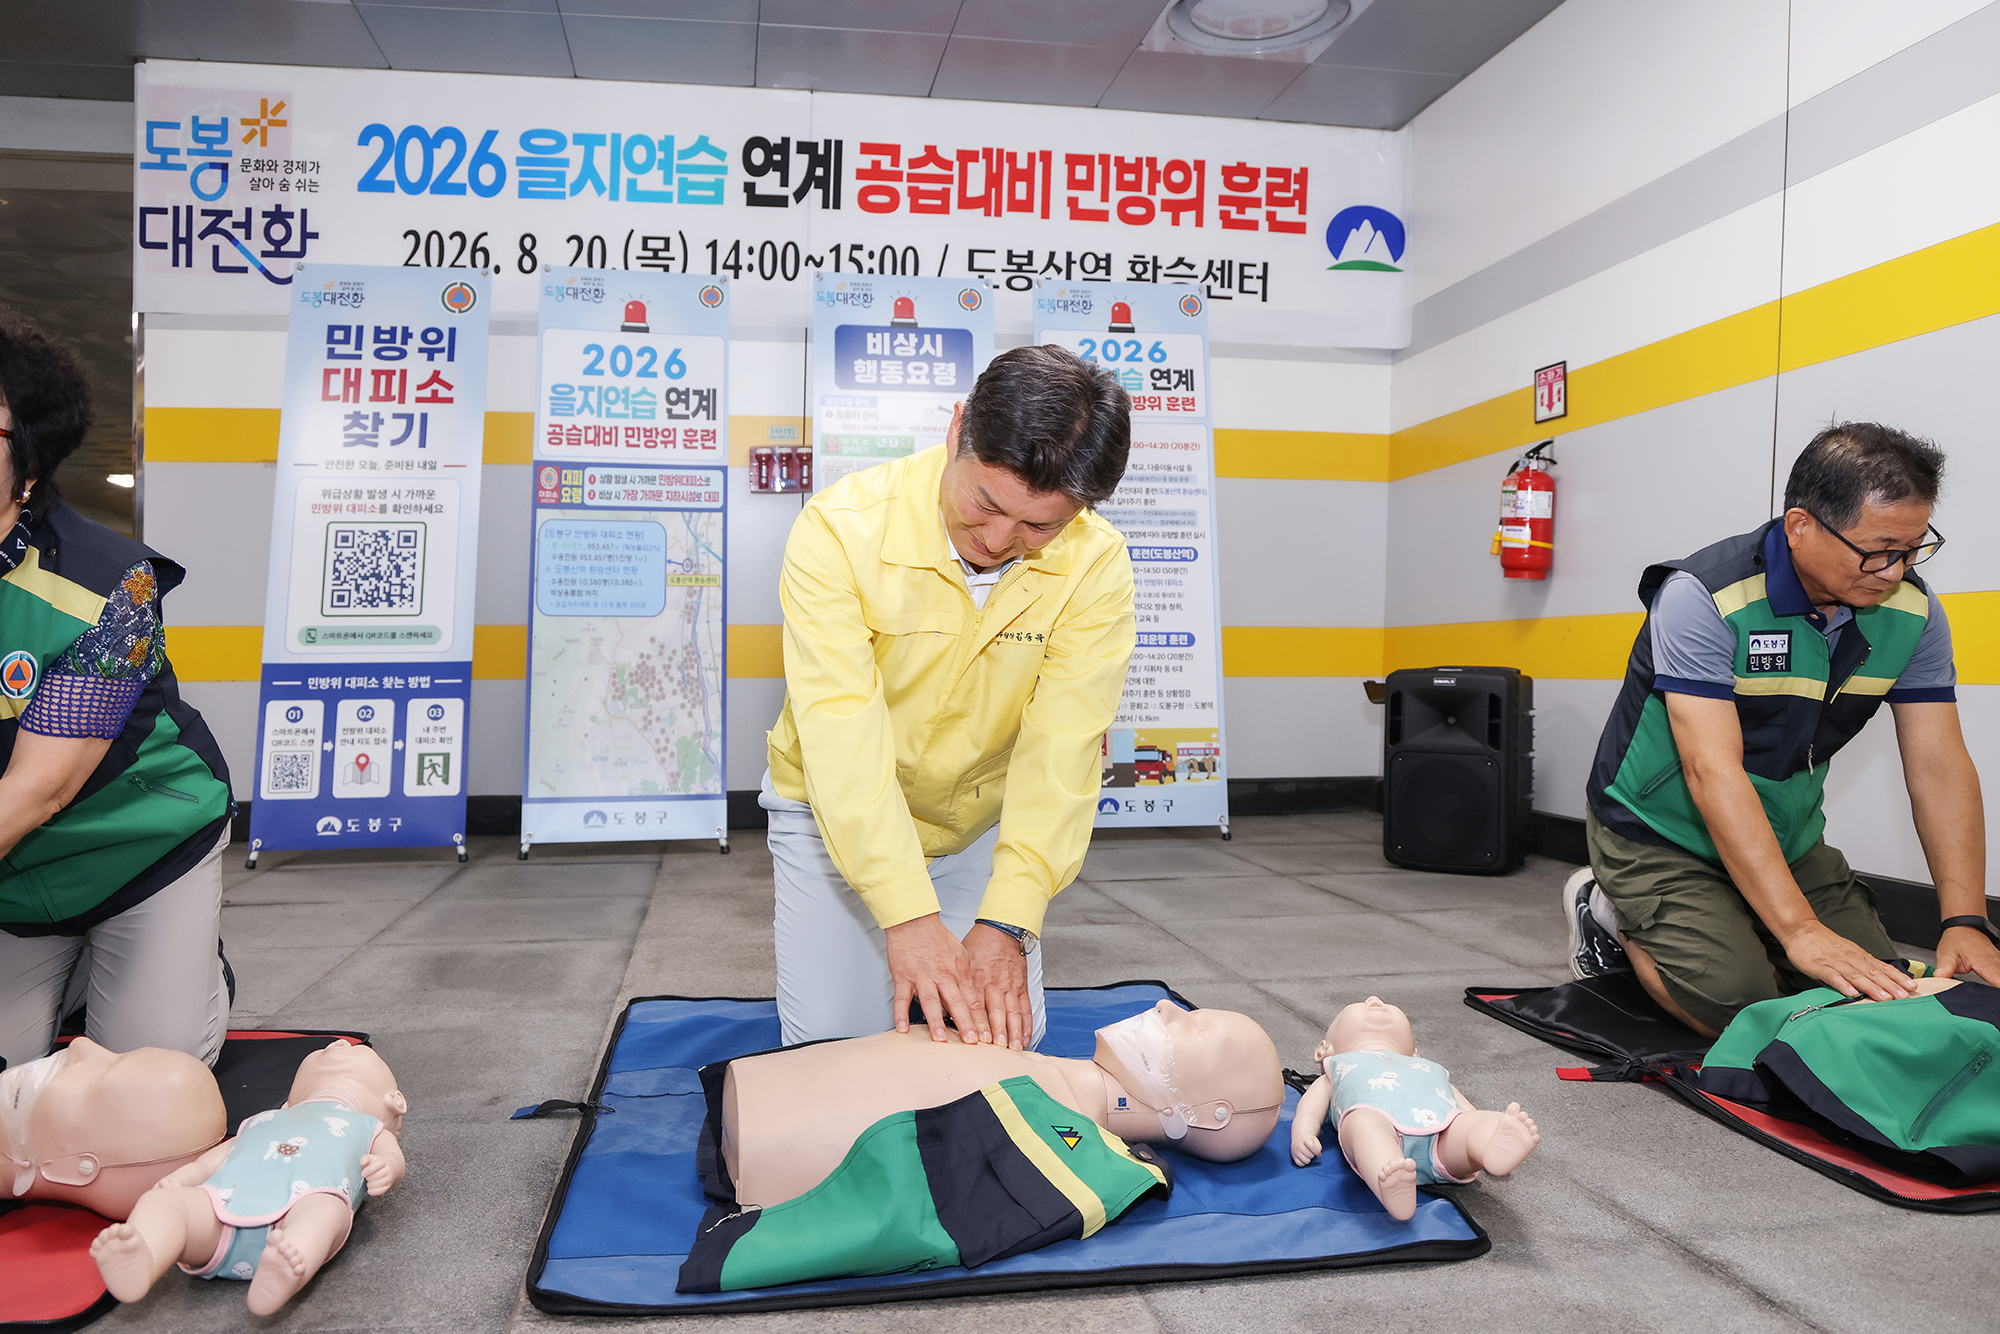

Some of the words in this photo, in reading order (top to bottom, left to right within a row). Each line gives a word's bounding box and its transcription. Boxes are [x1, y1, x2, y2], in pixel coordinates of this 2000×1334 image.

[140, 116, 232, 201] 도봉
[240, 158, 278, 173] 문화와
[282, 160, 320, 174] 경제가
[249, 177, 274, 191] 살아
[279, 178, 290, 192] 숨
[295, 178, 320, 193] 쉬는
[357, 124, 506, 197] 2026
[516, 128, 728, 205] 을지연습
[742, 135, 842, 210] 연계
[855, 141, 1052, 219] 공습대비
[1064, 153, 1205, 227] 민방위
[1217, 161, 1309, 235] 훈련
[139, 204, 319, 285] 대전환
[402, 229, 500, 275] 2026.
[705, 239, 920, 282] 14:00~15:00
[937, 243, 949, 278] /
[326, 324, 457, 362] 민방위
[866, 332, 943, 358] 비상시
[1078, 338, 1167, 363] 2026
[582, 343, 687, 380] 2026
[854, 359, 957, 386] 행동요령
[321, 367, 454, 404] 대피소
[1101, 367, 1144, 391] 습
[1150, 368, 1195, 392] 연계
[549, 383, 658, 420] 을지연습
[665, 387, 717, 421] 연계
[1166, 396, 1196, 412] 훈련
[343, 410, 428, 448] 찾기
[547, 423, 619, 447] 공습대비
[624, 426, 677, 450] 민방위
[682, 428, 717, 451] 훈련
[1171, 442, 1200, 451] (20분간)
[324, 459, 354, 470] 안전한
[358, 460, 380, 471] 오늘,
[384, 460, 414, 471] 준비된
[417, 460, 437, 471] 내일
[1132, 464, 1146, 472] 학교,
[1147, 464, 1185, 472] 다중이용시설
[561, 469, 583, 486] 대피
[599, 474, 613, 485] 상황
[614, 475, 628, 485] 발생
[629, 475, 636, 486] 시
[637, 475, 657, 486] 가까운
[658, 475, 711, 487] 민방위대피소로
[321, 488, 363, 500] 위급상황
[366, 489, 388, 500] 발생
[391, 489, 401, 500] 시
[404, 489, 436, 500] 가까운
[561, 487, 582, 503] 요령
[598, 490, 612, 500] 비상
[613, 490, 621, 500] 시
[622, 490, 638, 501] 가장
[640, 490, 663, 501] 가까운
[665, 490, 702, 502] 지하시설로
[704, 491, 719, 503] 대피
[311, 503, 342, 514] 민방위
[346, 503, 388, 514] 대피소를
[392, 503, 444, 514] 확인하세요
[1143, 498, 1156, 506] 훈련
[1131, 548, 1194, 559] 훈련(도봉산역)
[1162, 567, 1188, 575] (50분간)
[1169, 634, 1188, 645] 훈련
[1763, 640, 1786, 648] 도봉구
[1167, 653, 1193, 661] (20분간)
[1750, 655, 1786, 670] 민방위
[1143, 665, 1162, 673] 지휘차
[1164, 665, 1170, 673] 등
[1172, 665, 1183, 673] 6대
[307, 677, 342, 690] 민방위
[344, 677, 379, 690] 대피소
[382, 676, 405, 690] 찾는
[407, 676, 431, 689] 방법
[1142, 677, 1155, 685] 대한
[1143, 690, 1156, 698] 훈련
[1157, 690, 1164, 698] 등
[1166, 690, 1191, 698] 상황점검
[1130, 702, 1149, 710] 문화고
[1159, 702, 1185, 710] 도봉구청
[1194, 702, 1214, 710] 도봉역
[287, 709, 301, 720] 01
[358, 708, 373, 719] 02
[427, 707, 443, 719] 03
[271, 728, 316, 736] 스마트폰에서
[341, 727, 363, 735] 민방위
[365, 727, 387, 735] 대피소
[422, 726, 430, 734] 내
[432, 726, 446, 734] 주변
[271, 739, 297, 747] QR코드
[340, 738, 354, 746] 안내
[356, 738, 371, 746] 지도
[415, 736, 437, 745] 대피소
[439, 736, 453, 745] 확인
[1125, 800, 1174, 813] 도봉구
[614, 811, 667, 825] 도봉구
[346, 817, 402, 833] 도봉구
